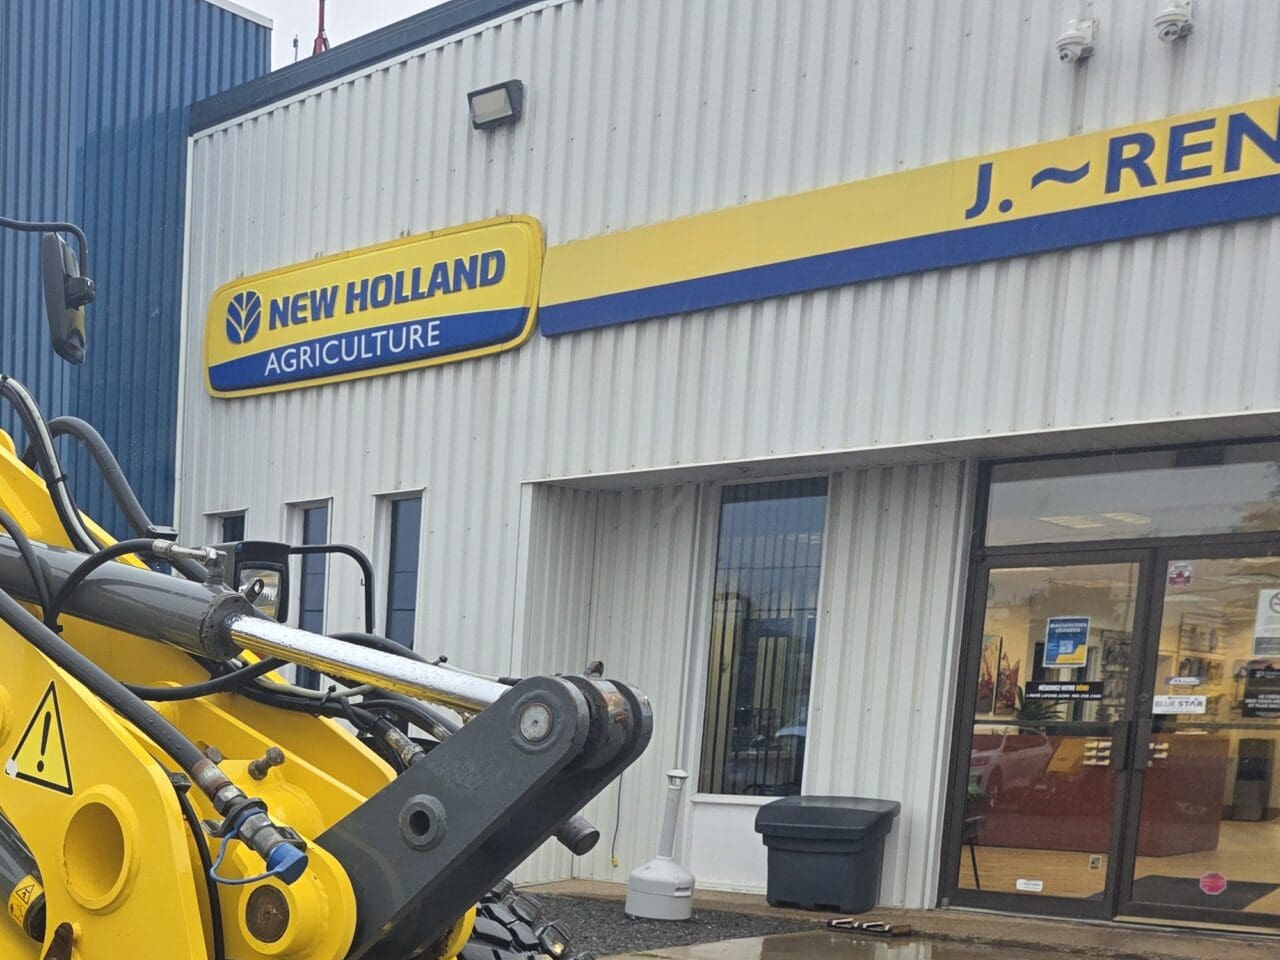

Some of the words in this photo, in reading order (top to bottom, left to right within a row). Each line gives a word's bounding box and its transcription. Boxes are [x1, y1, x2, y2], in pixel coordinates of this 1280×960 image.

[269, 285, 339, 330] NEW
[345, 249, 506, 314] HOLLAND
[264, 321, 441, 376] AGRICULTURE
[1178, 699, 1204, 707] STAR
